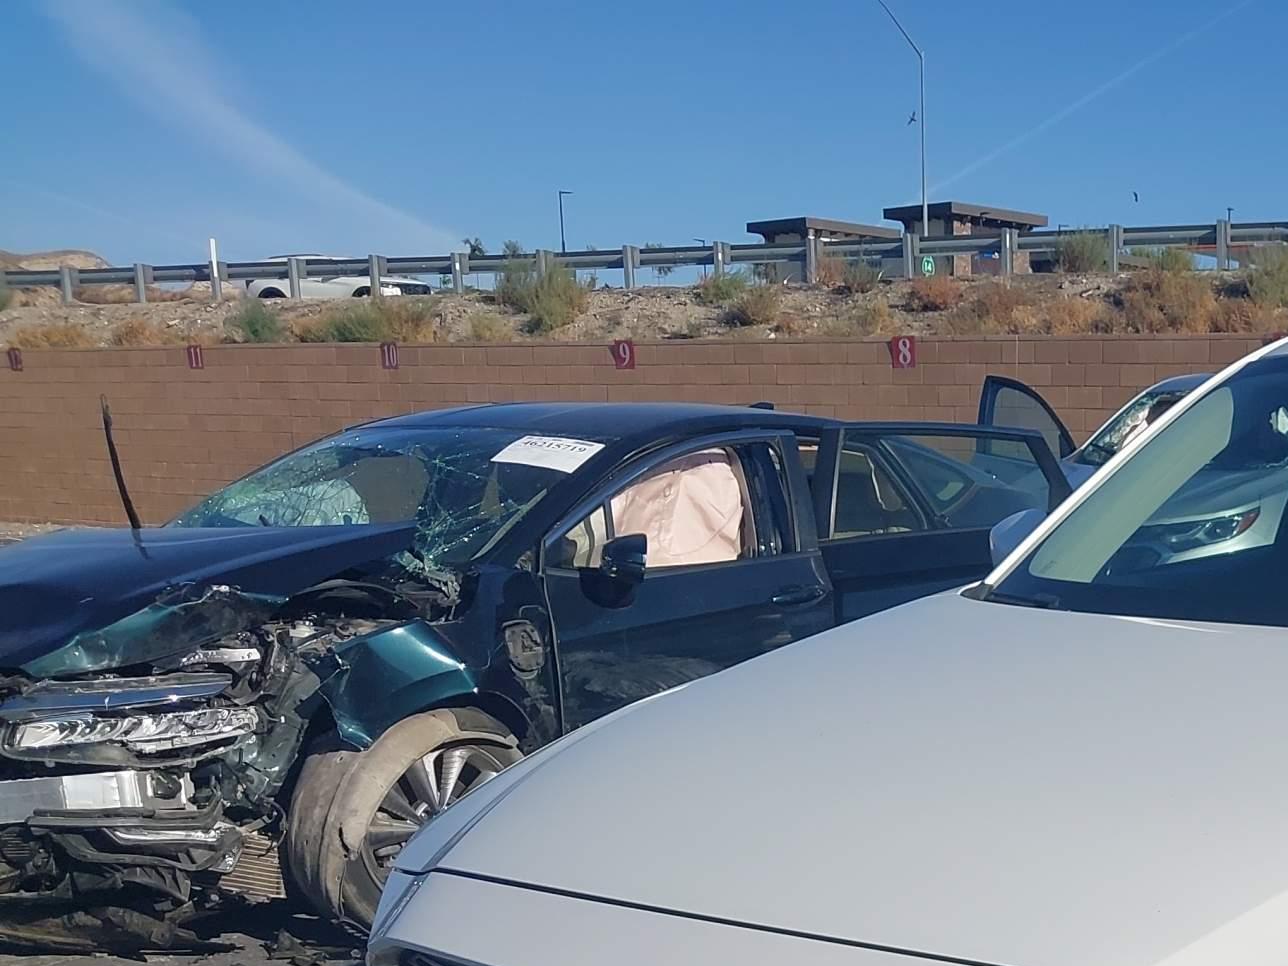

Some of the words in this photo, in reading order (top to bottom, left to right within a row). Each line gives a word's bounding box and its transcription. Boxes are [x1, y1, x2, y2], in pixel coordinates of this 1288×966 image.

[190, 347, 202, 367] 11
[384, 344, 397, 367] 10
[619, 343, 630, 366] 9
[898, 338, 911, 365] 8
[523, 440, 587, 453] 46215719
